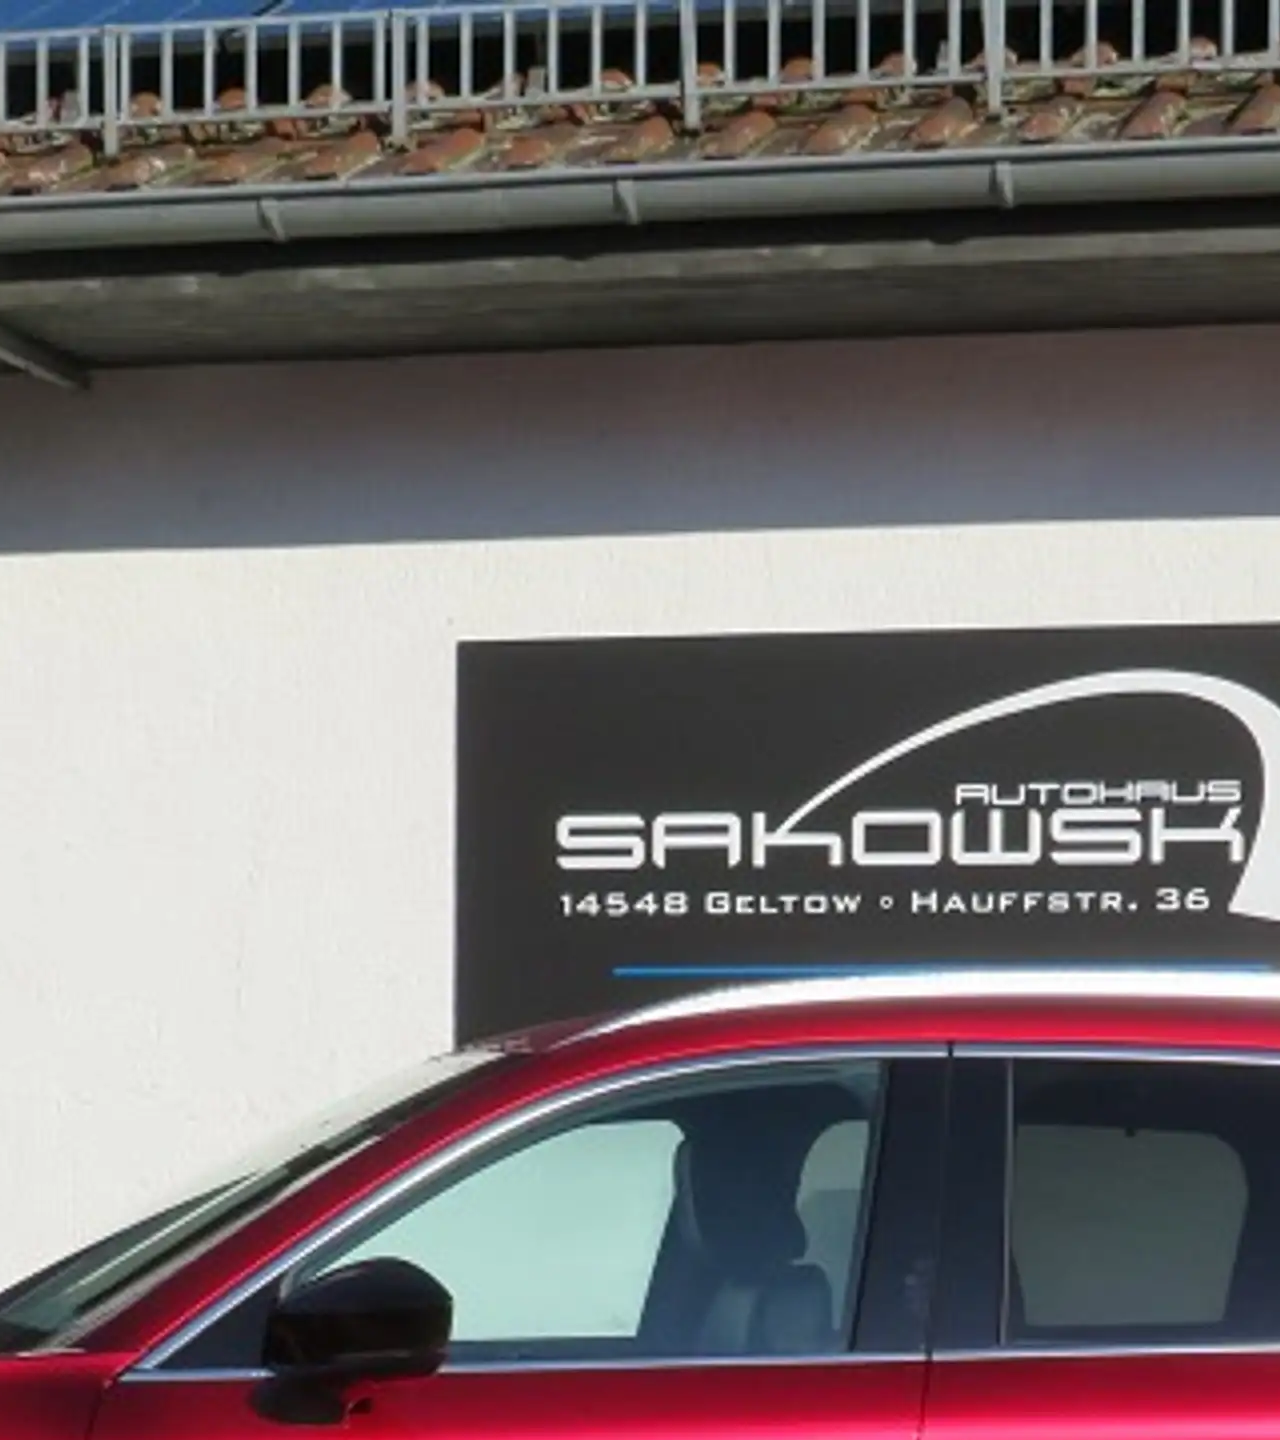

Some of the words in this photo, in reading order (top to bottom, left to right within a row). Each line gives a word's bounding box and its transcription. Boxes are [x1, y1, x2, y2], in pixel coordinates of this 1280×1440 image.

[955, 779, 1243, 806] AUTOHAUS
[559, 890, 689, 916] 14548
[1155, 887, 1211, 912] 36
